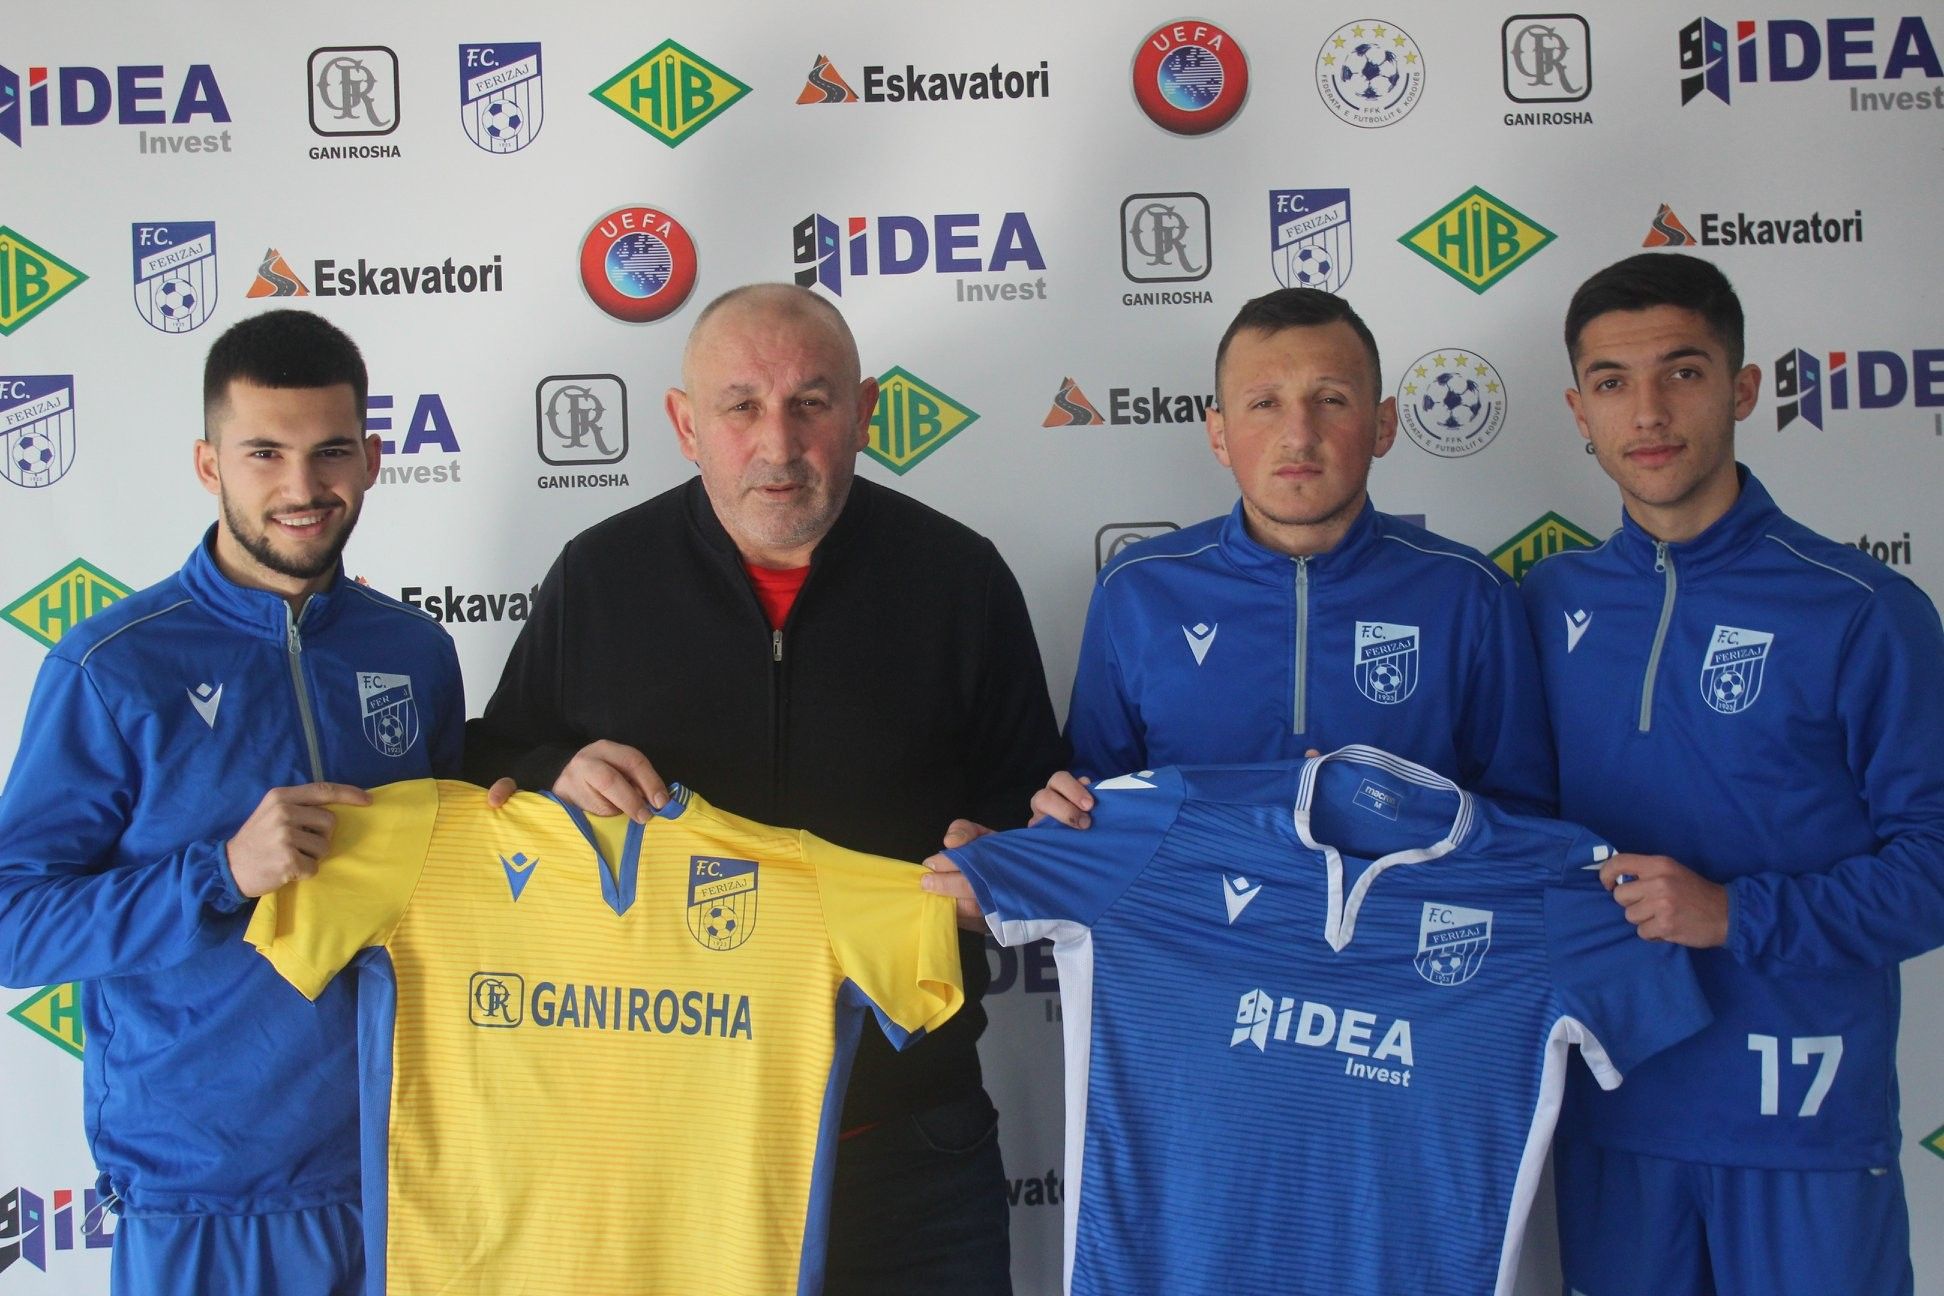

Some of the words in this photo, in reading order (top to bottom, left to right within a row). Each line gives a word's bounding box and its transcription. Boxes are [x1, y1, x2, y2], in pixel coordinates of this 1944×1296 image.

[1152, 26, 1223, 51] UEFA
[475, 63, 529, 92] FERIZAJ
[863, 61, 1050, 103] Eskavatori
[1850, 86, 1944, 111] Invest
[1503, 112, 1593, 126] GANIROSHA
[138, 131, 232, 154] Invest
[309, 145, 401, 160] GANIROSHA
[600, 212, 672, 238] UEFA
[1286, 210, 1338, 238] FERIZAJ
[1700, 210, 1863, 246] Eskavatori
[148, 243, 203, 271] FERIZAJ
[314, 255, 503, 297] Eskavatori
[955, 278, 1047, 303] Invest
[1122, 291, 1213, 306] GANIROSHA
[6, 397, 61, 425] FERIZAJ
[1109, 387, 1214, 425] Eskav
[366, 394, 461, 455] EA
[376, 459, 461, 485] nvest
[537, 474, 630, 489] GANIROSHA
[401, 583, 539, 623] Eskava
[1364, 640, 1411, 657] FERIZAJ
[1715, 647, 1761, 663] FERIZAJ
[701, 878, 748, 897] FERIZAJ
[1432, 928, 1480, 943] FERIZAJ
[531, 981, 753, 1040] GANIROSHA
[1345, 1057, 1411, 1088] Invest
[1747, 1033, 1844, 1117] 17
